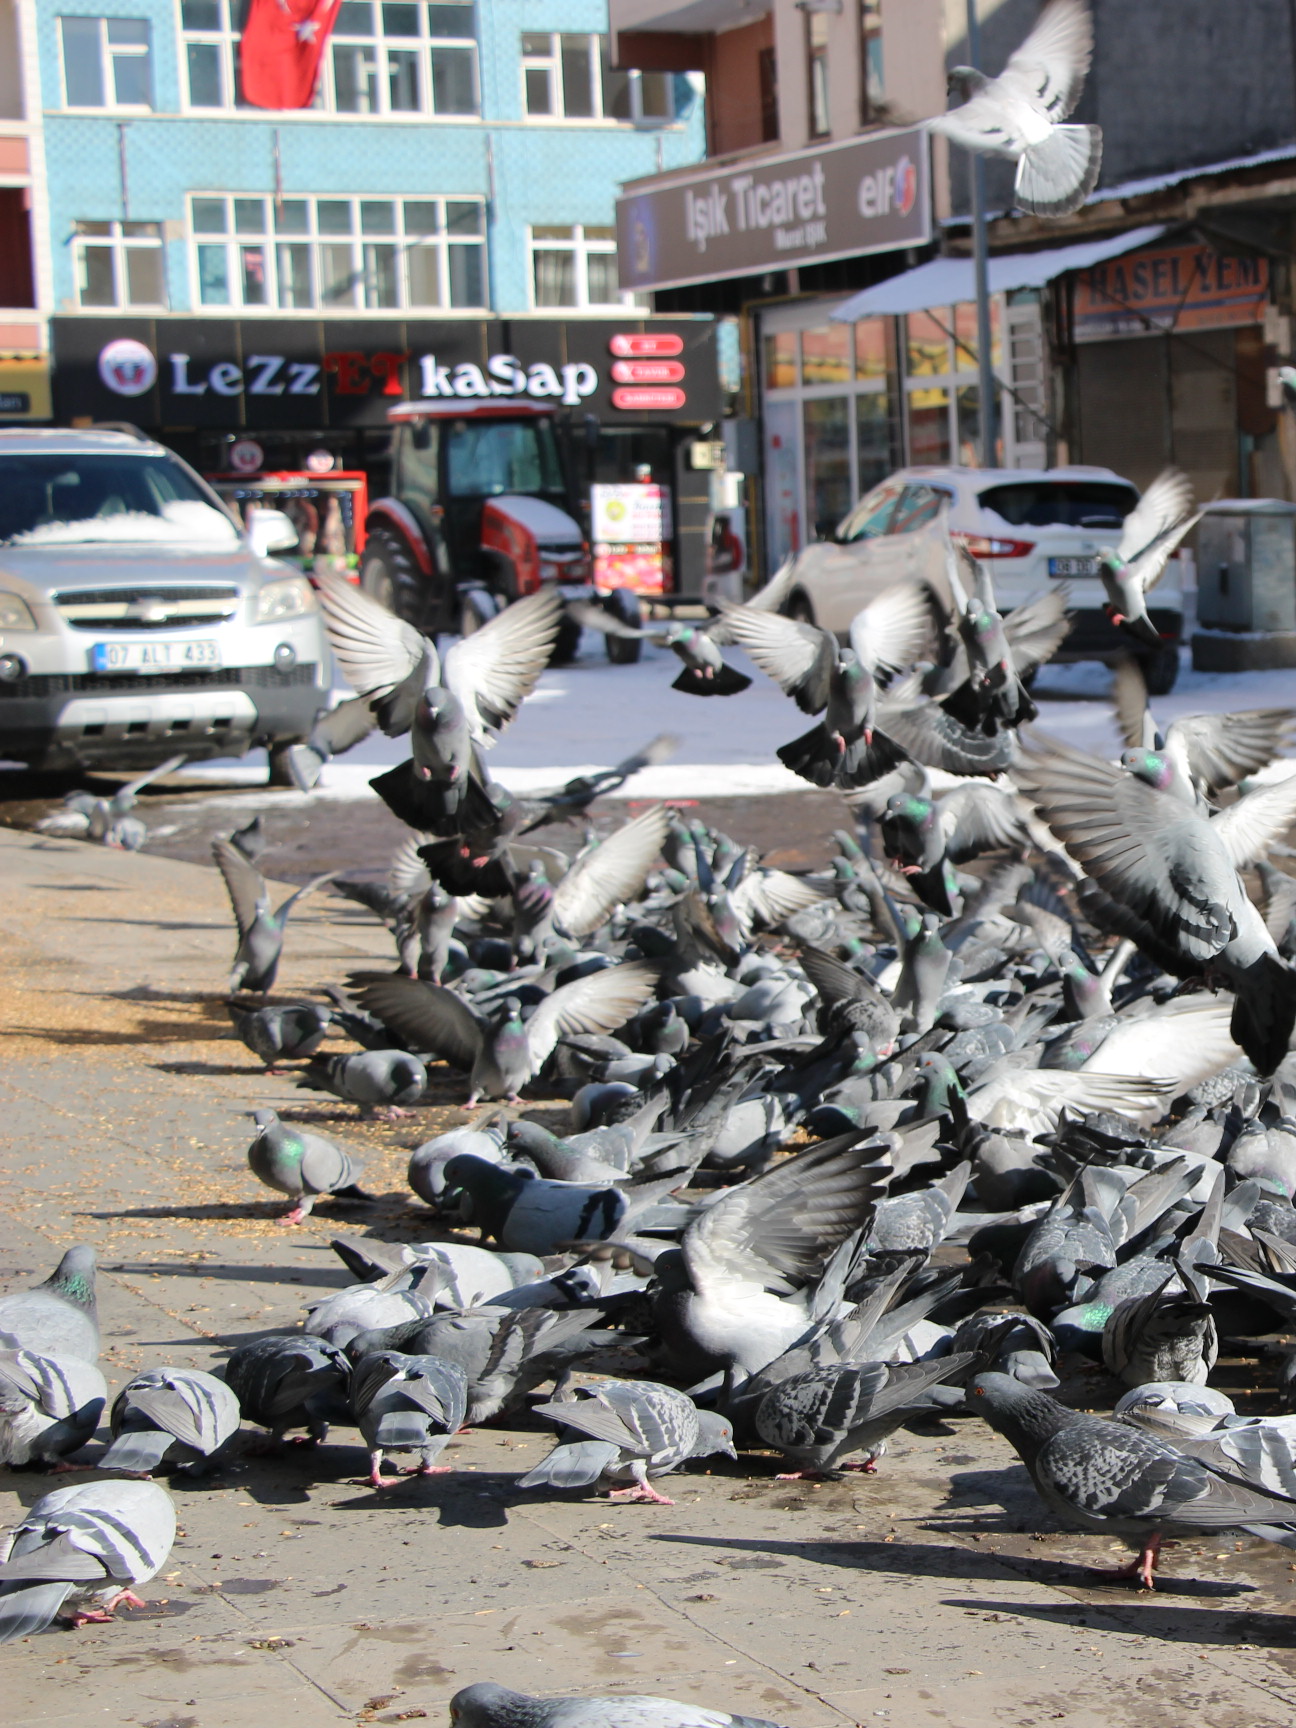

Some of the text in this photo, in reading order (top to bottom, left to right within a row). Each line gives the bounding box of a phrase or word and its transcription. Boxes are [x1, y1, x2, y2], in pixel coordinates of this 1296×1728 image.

[732, 160, 826, 230] Ticaret
[857, 166, 895, 218] elf
[1194, 254, 1262, 293] YEM
[419, 353, 599, 406] kaSap
[109, 642, 218, 666] 07 ALT 433
